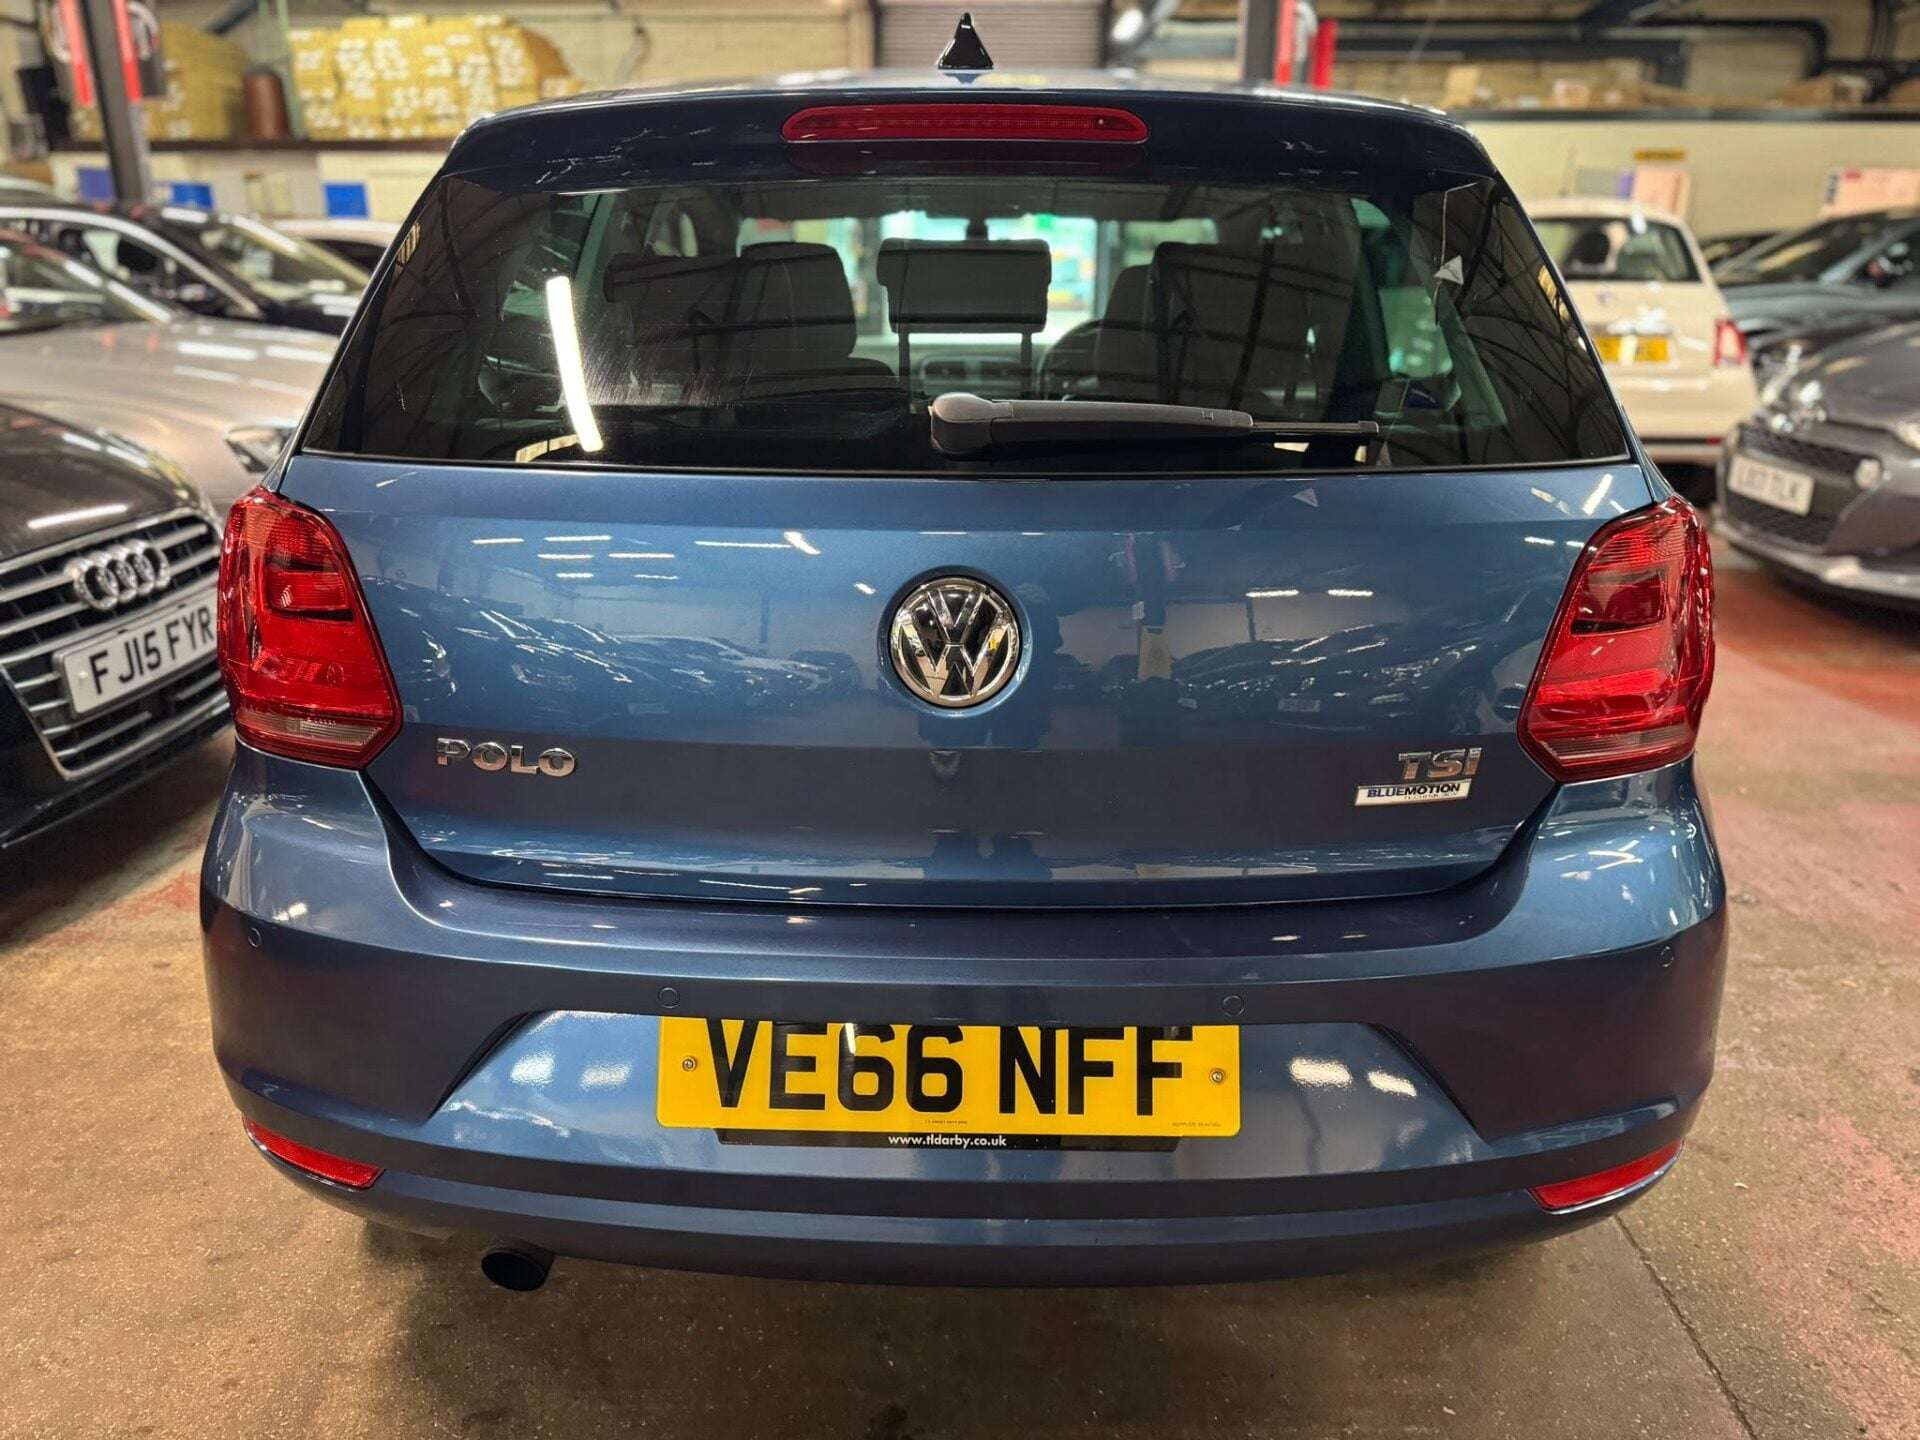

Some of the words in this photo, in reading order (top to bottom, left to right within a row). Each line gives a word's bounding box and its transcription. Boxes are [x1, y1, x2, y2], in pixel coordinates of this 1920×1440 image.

[88, 630, 162, 696] FJ15
[165, 606, 215, 663] FYR
[436, 737, 576, 778] POLO
[1366, 783, 1461, 798] BLUEMOTION
[705, 1017, 964, 1113] VE66
[998, 1025, 1193, 1116] NFF
[887, 1133, 1008, 1150] www.tldarby.co.uk
